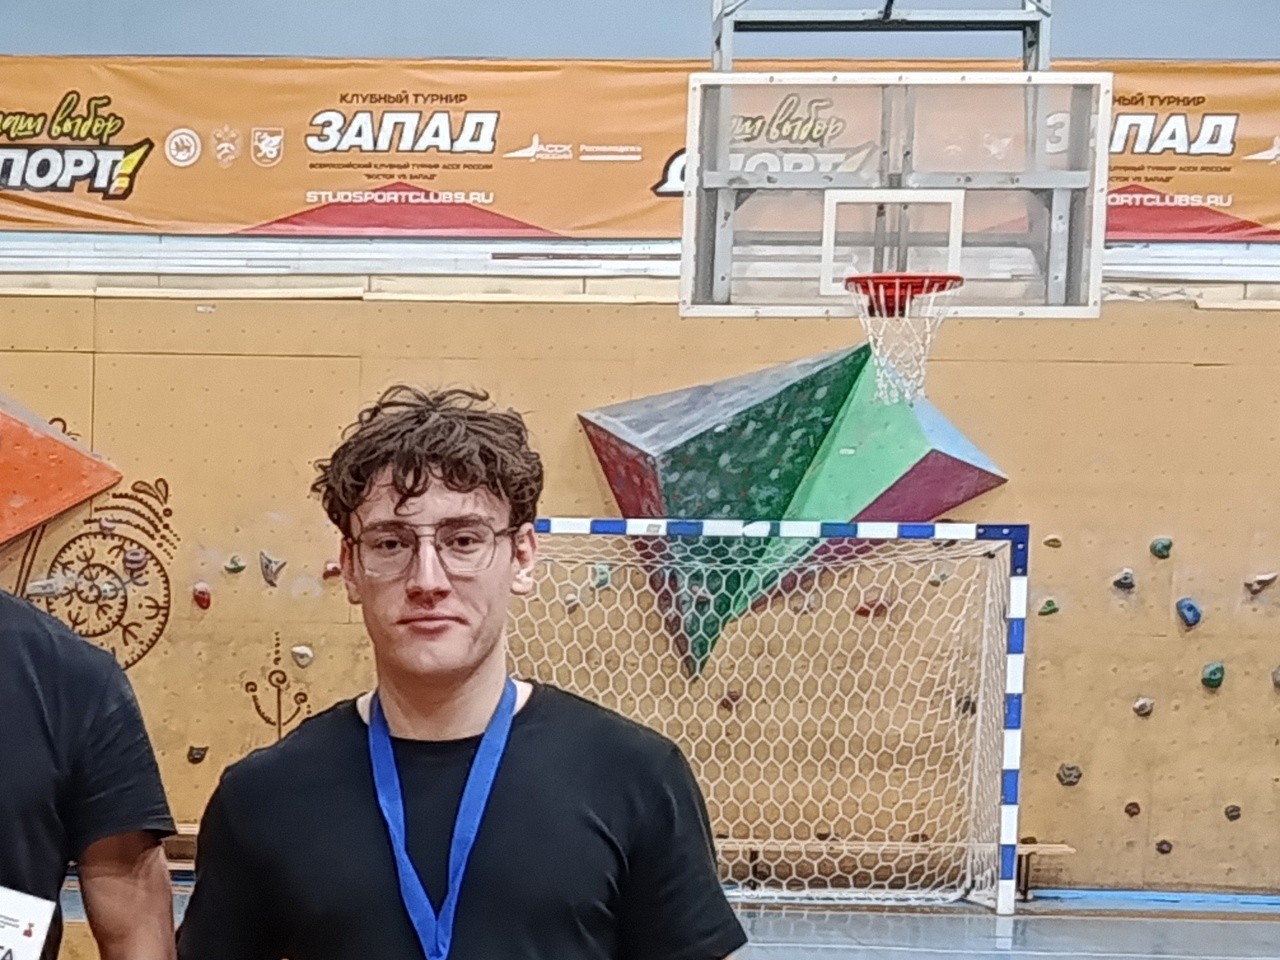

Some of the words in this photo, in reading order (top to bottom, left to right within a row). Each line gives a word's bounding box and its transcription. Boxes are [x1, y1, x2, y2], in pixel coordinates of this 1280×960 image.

[339, 91, 409, 104] КЛУБНЫЙ
[412, 93, 468, 104] ТУРНИР
[1148, 95, 1206, 106] ТУРНИР
[49, 91, 124, 144] выбор
[305, 110, 500, 153] ЗАПАД
[767, 93, 846, 146] выбор
[305, 190, 494, 204] STUDSPORTCLUBS.RU
